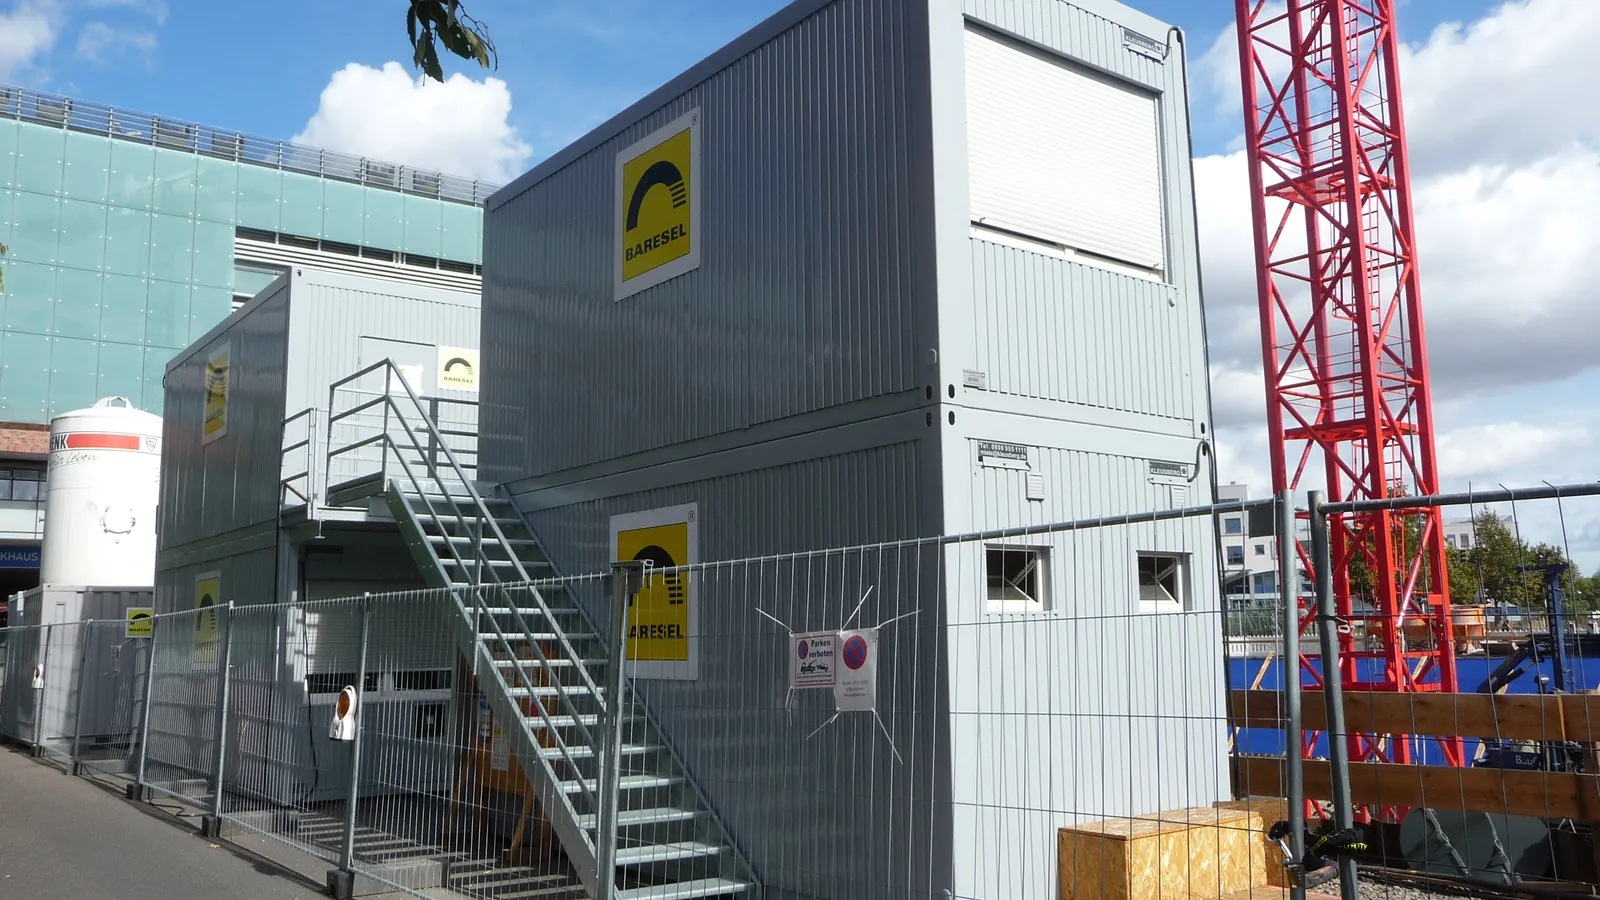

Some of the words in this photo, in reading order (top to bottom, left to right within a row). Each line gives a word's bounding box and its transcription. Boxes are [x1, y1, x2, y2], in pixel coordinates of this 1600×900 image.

[625, 223, 687, 262] BARESEL
[443, 376, 474, 384] BARESEL
[0, 552, 39, 561] KHAUS
[628, 623, 684, 639] ARESEL
[811, 639, 831, 647] Parken
[809, 650, 833, 658] verboten
